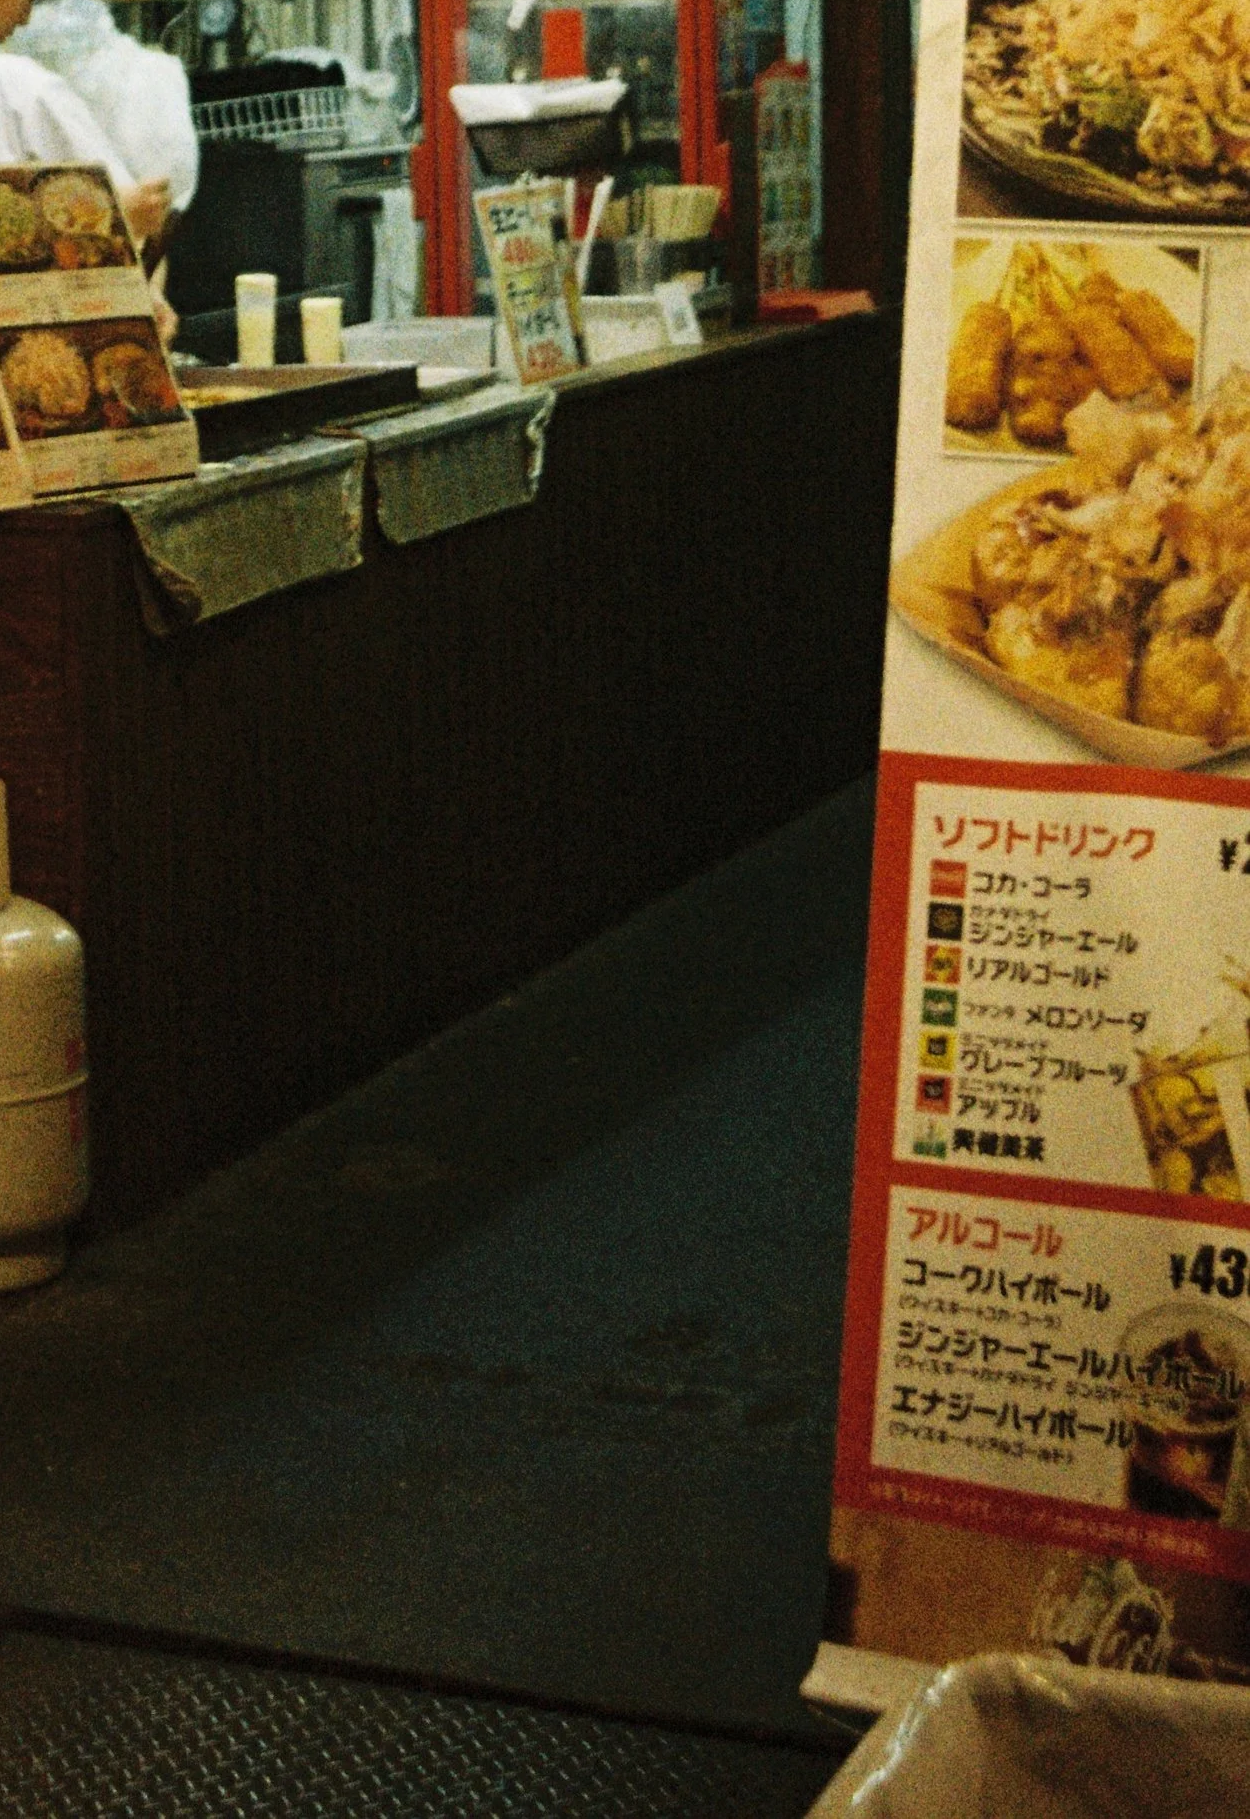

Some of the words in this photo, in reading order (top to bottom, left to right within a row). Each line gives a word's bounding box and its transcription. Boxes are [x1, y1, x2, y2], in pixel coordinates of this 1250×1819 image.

[934, 814, 1156, 862] ソフトドリンク
[972, 871, 1092, 899] コカ・コーラ
[906, 1206, 1064, 1259] アルコール
[901, 1257, 1112, 1313] コークハイボール
